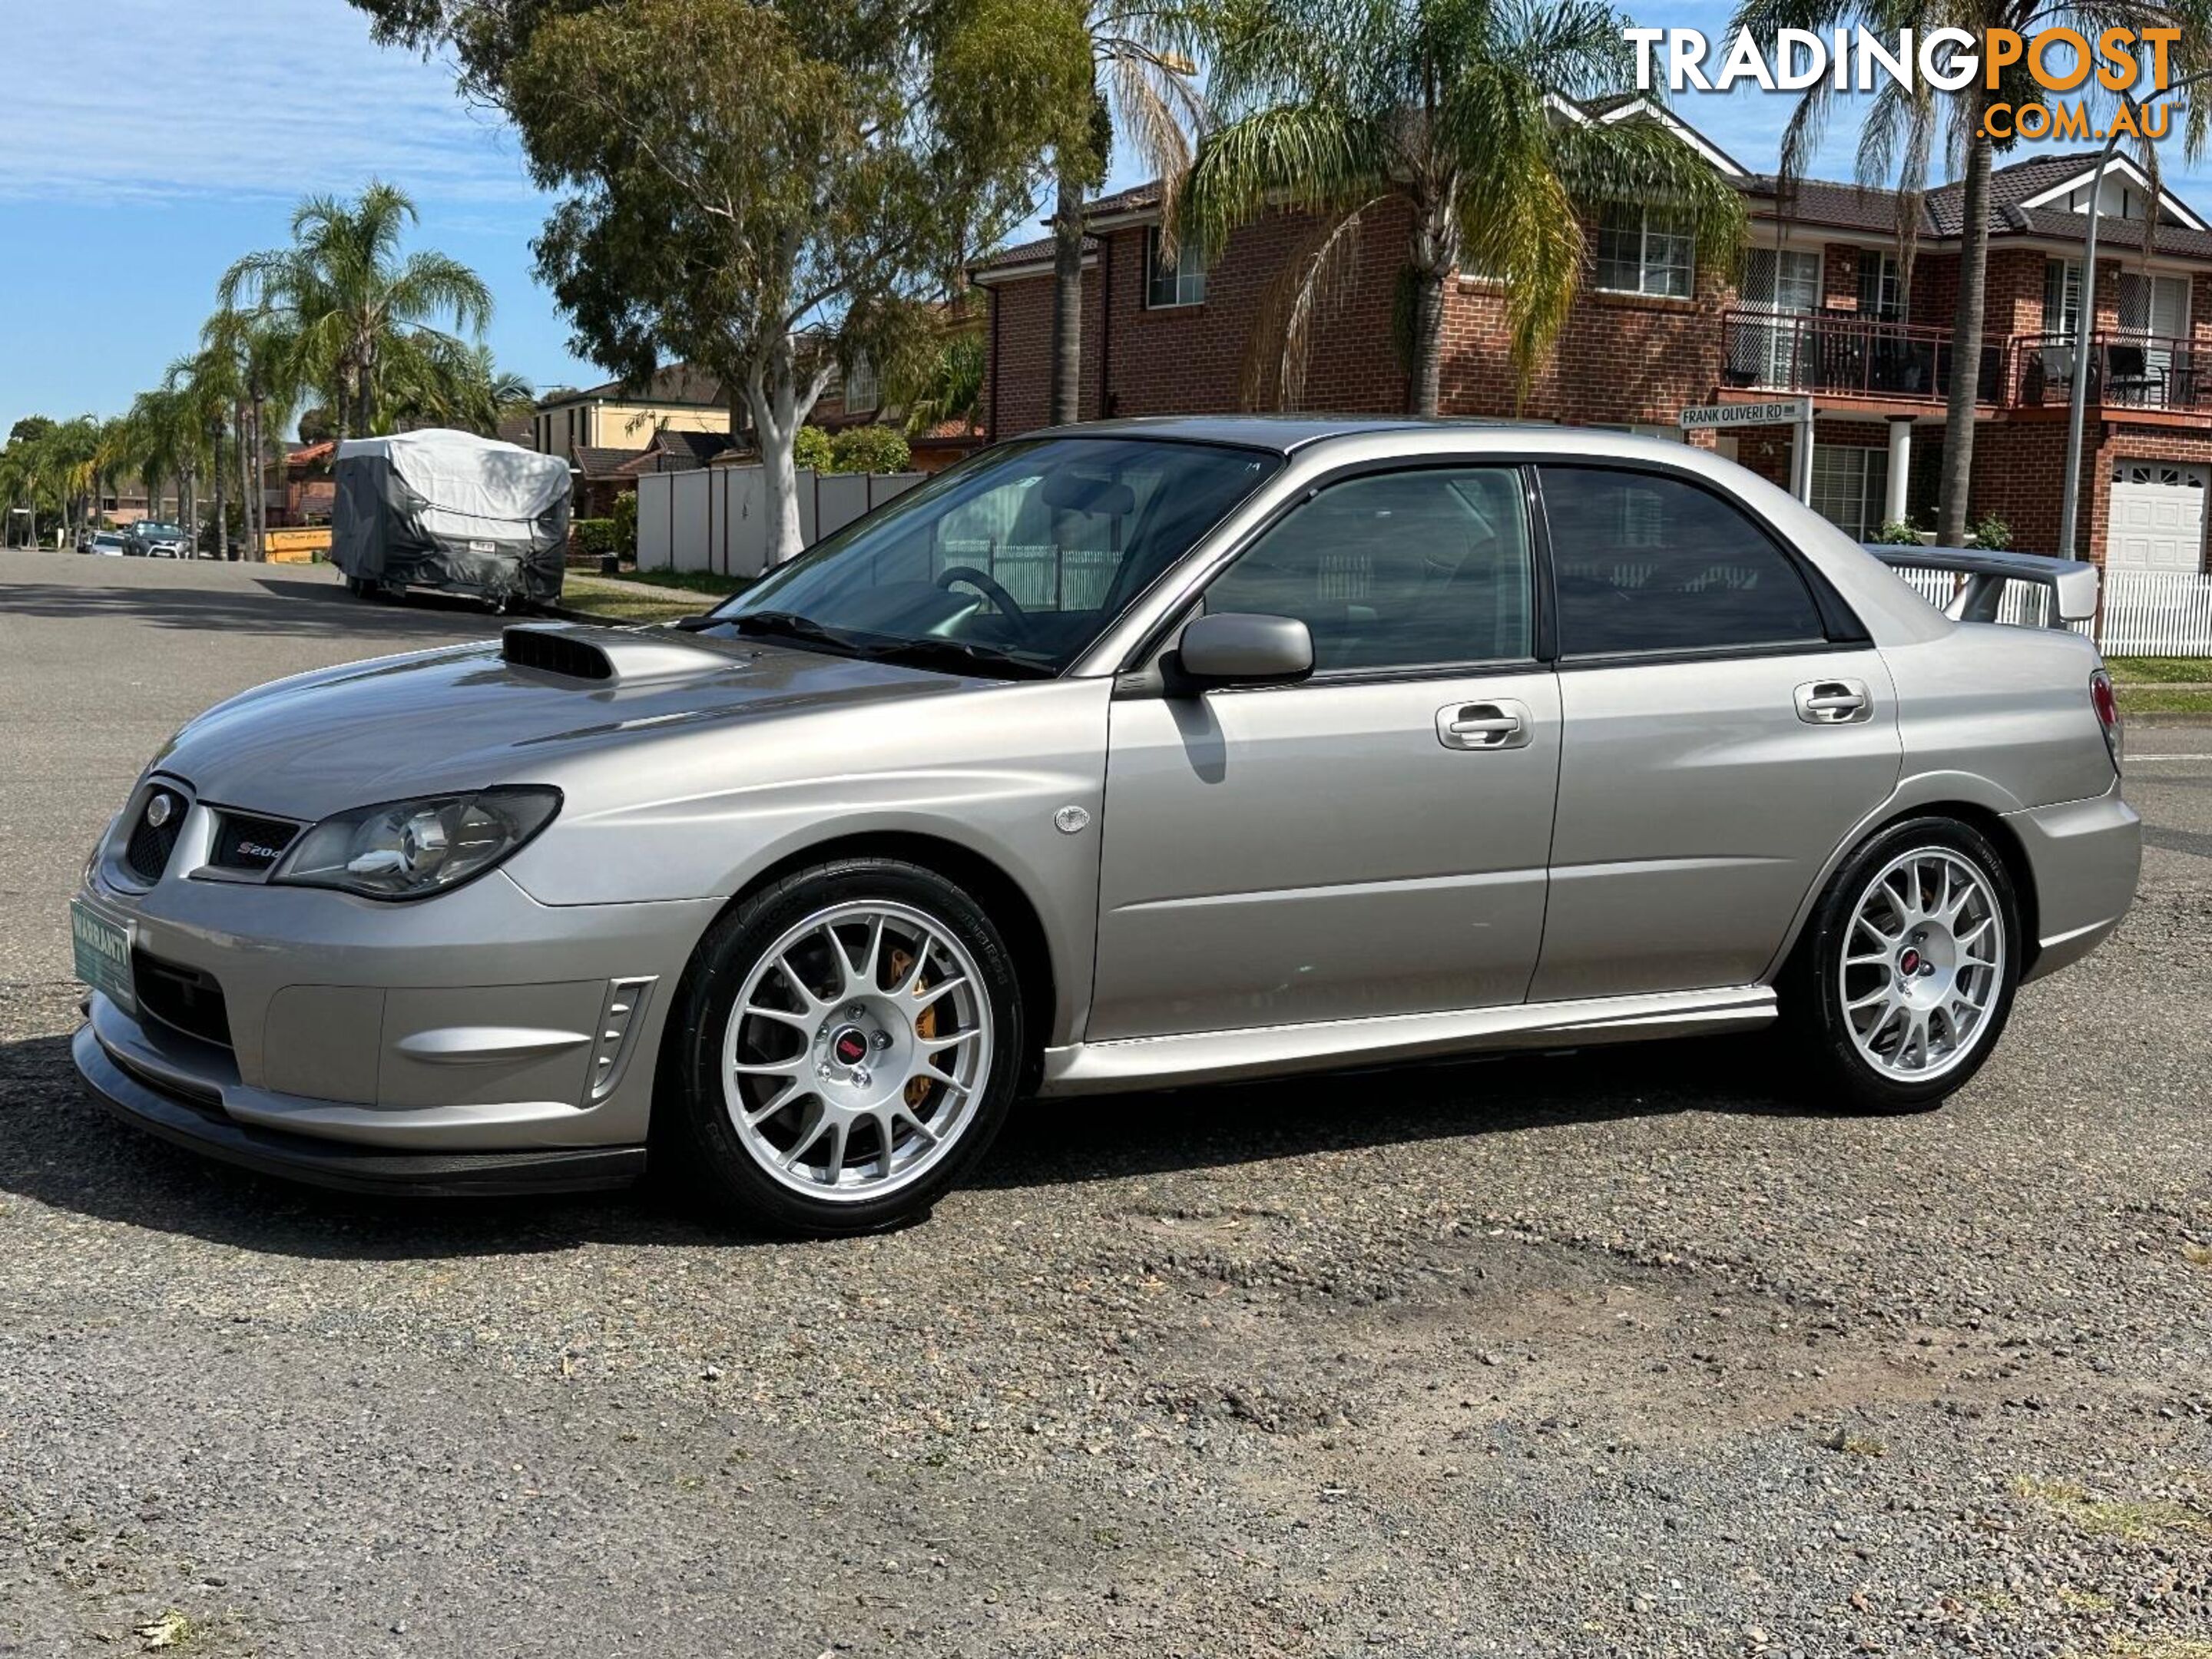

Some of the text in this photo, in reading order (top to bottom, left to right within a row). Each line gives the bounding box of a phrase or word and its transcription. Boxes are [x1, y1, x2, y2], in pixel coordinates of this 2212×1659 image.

[1684, 409, 1720, 423] FRANK
[1722, 406, 1763, 421] OLIVERI
[1767, 405, 1782, 418] RD
[72, 911, 127, 966] WARRANTY
